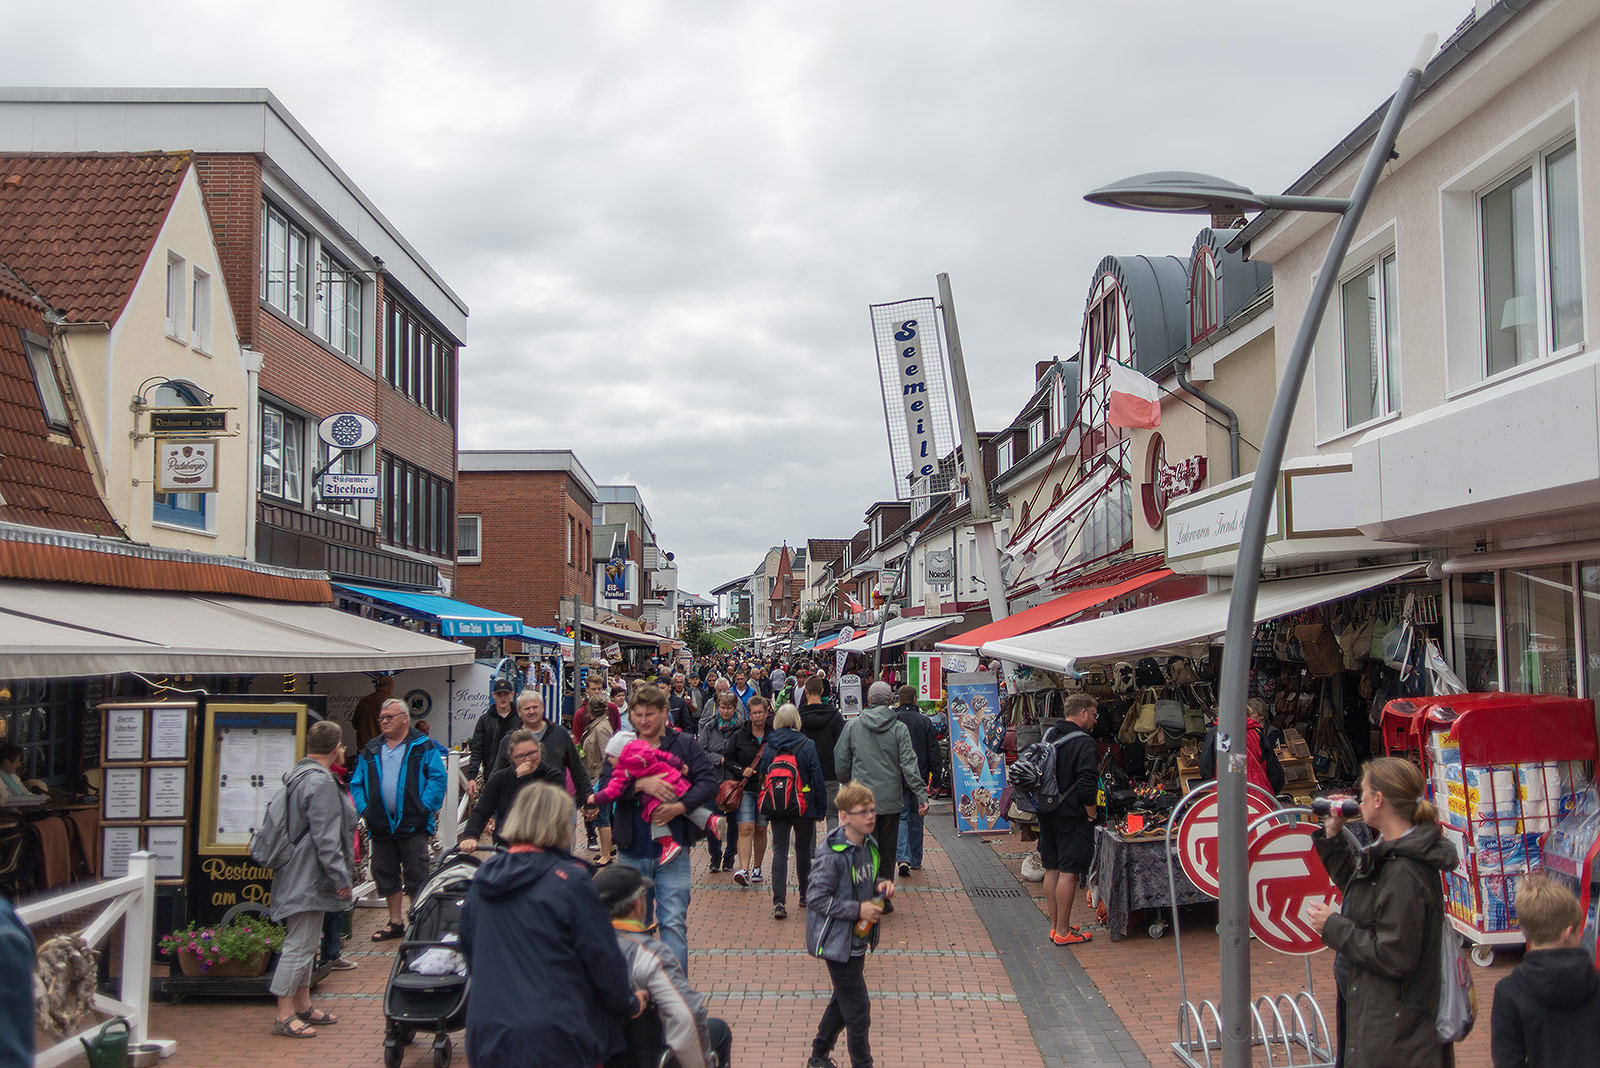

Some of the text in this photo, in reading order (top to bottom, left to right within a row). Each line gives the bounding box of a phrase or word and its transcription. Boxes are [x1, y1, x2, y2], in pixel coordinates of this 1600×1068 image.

[894, 319, 935, 477] Seemeile
[167, 457, 206, 474] Radeberger
[325, 484, 376, 495] Theehaus
[332, 475, 369, 483] Büsumer
[1175, 522, 1210, 546] Lederwaren
[1214, 510, 1238, 537] Trends
[921, 661, 929, 695] EIS
[453, 688, 490, 702] Restau
[201, 858, 275, 881] Restaur
[211, 883, 271, 907] am Pa
